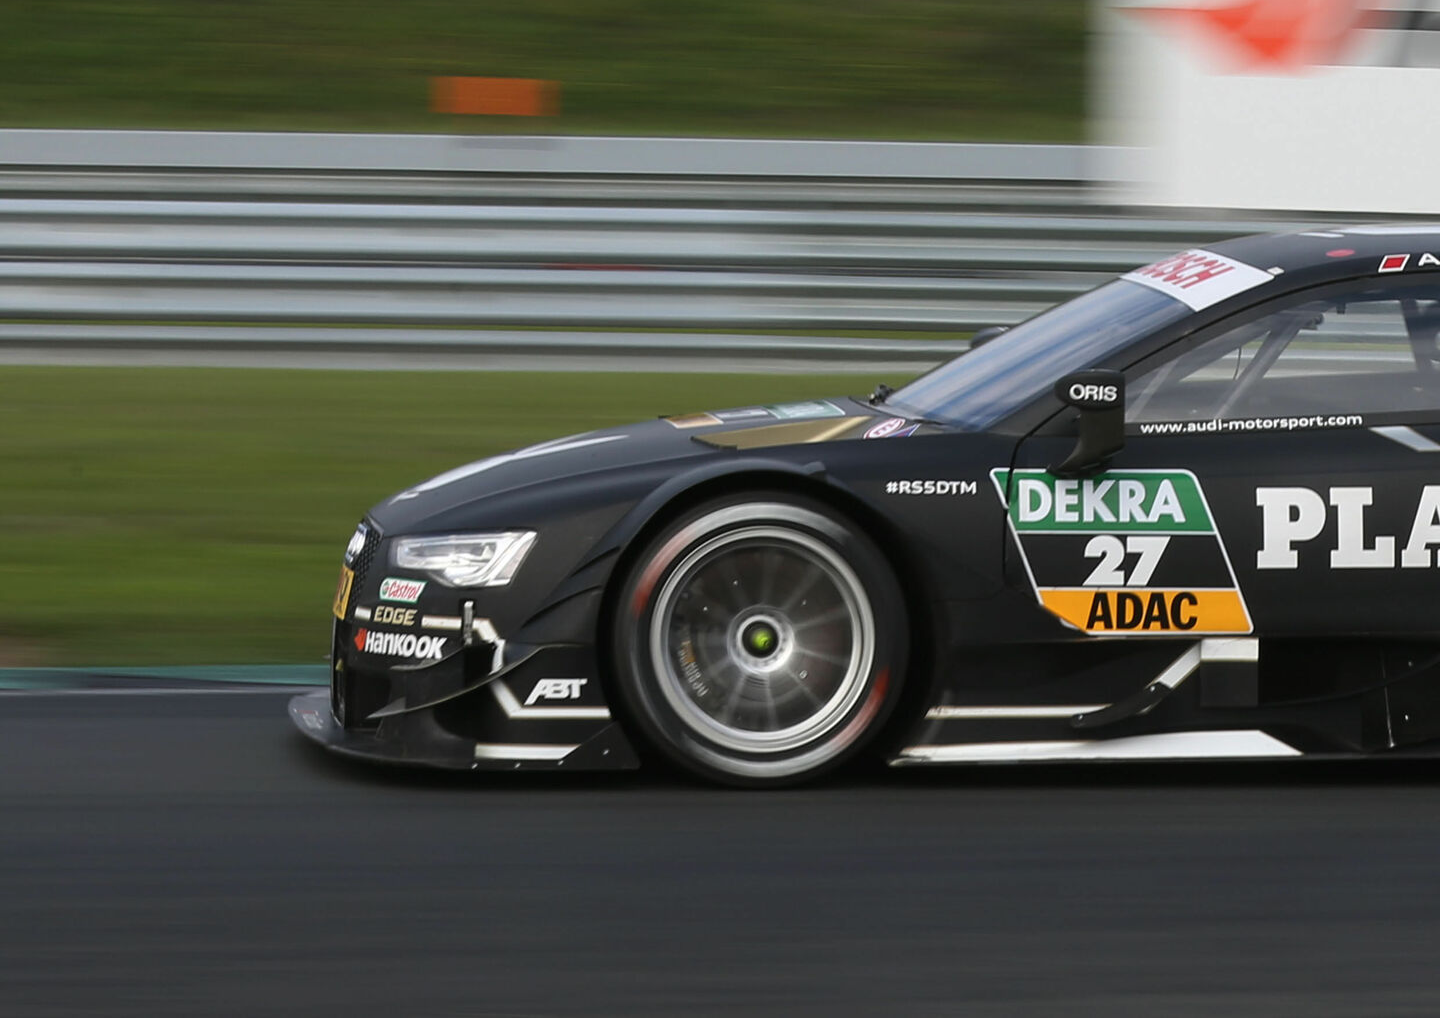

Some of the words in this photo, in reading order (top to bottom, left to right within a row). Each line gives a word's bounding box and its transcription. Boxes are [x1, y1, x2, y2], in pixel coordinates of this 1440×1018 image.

[1069, 383, 1118, 402] ORIS
[1140, 414, 1363, 434] www.audi-motorsport.com
[885, 480, 978, 495] #RS5DTM
[1018, 479, 1186, 523] DEKRA
[1082, 535, 1171, 586] 27
[388, 580, 420, 600] Castrol
[373, 605, 418, 626] EDGE
[1086, 592, 1198, 630] ADAC
[523, 678, 588, 706] ABT
